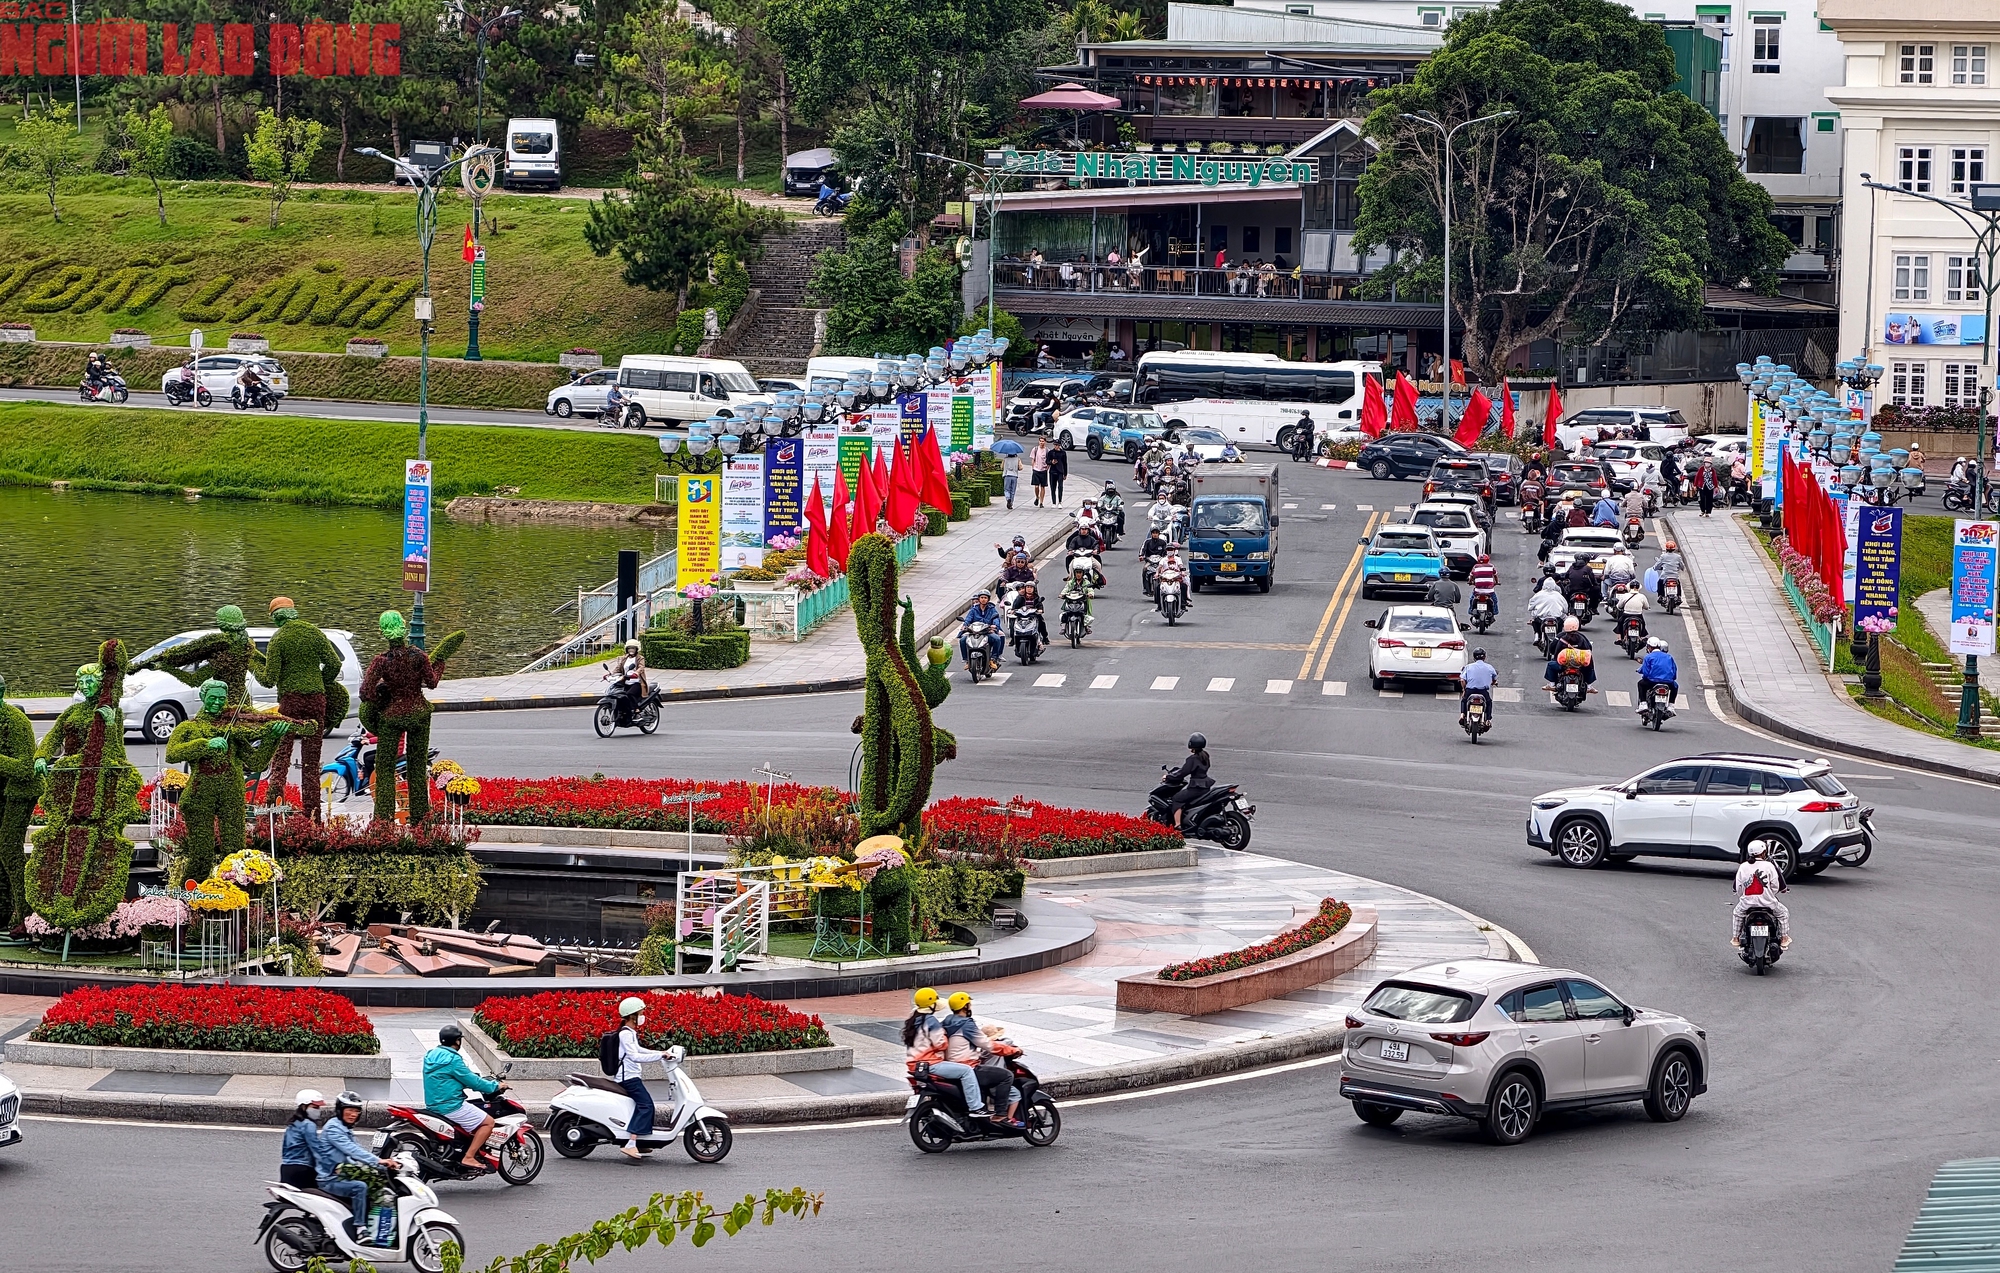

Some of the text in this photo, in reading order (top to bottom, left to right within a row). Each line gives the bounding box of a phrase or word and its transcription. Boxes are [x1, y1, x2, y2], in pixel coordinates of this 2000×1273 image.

[1001, 149, 1311, 188] Café Nhật Nguyên
[1383, 1050, 1404, 1059] 332.55
